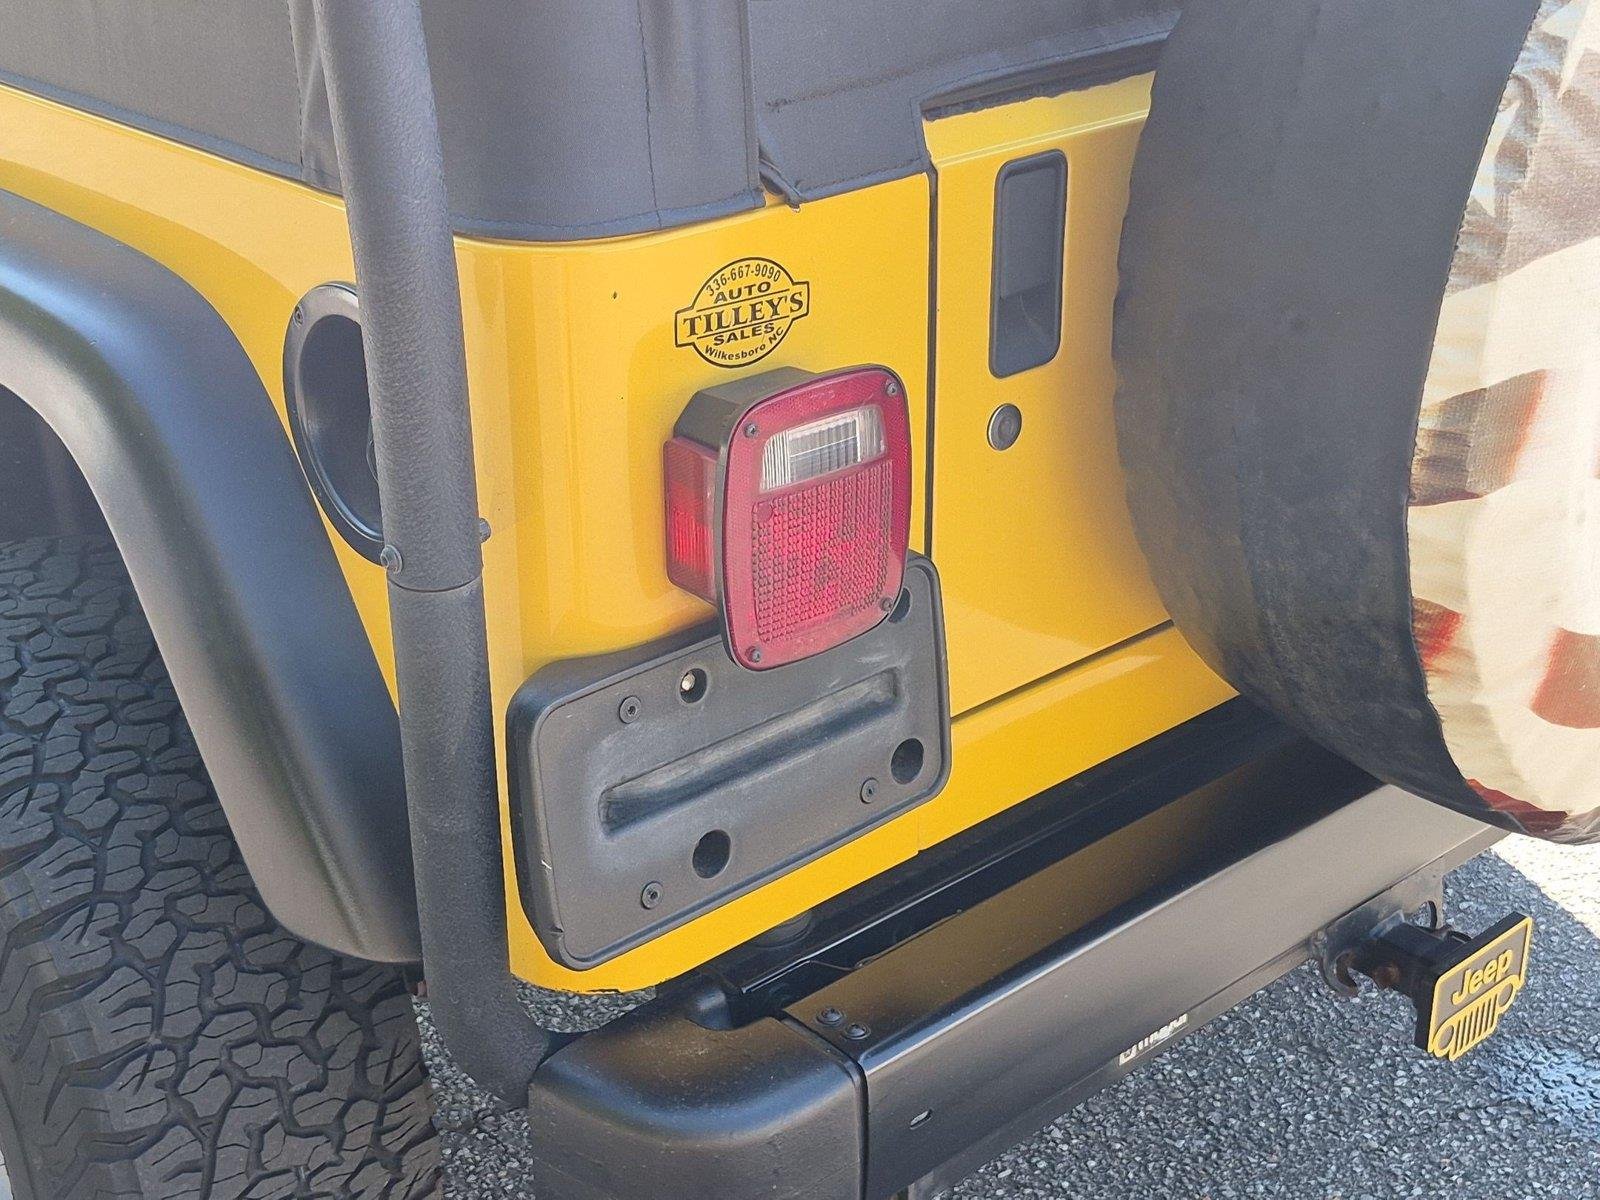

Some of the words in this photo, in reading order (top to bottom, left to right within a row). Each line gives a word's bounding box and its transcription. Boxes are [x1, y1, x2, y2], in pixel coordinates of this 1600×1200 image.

[706, 263, 781, 297] 336-667-9090
[713, 281, 771, 305] AUTO
[682, 291, 804, 338] TILLEY'S
[704, 343, 766, 361] Wilkesboro
[768, 326, 784, 344] NC
[713, 322, 775, 346] SALES
[1451, 949, 1513, 1005] Jeep
